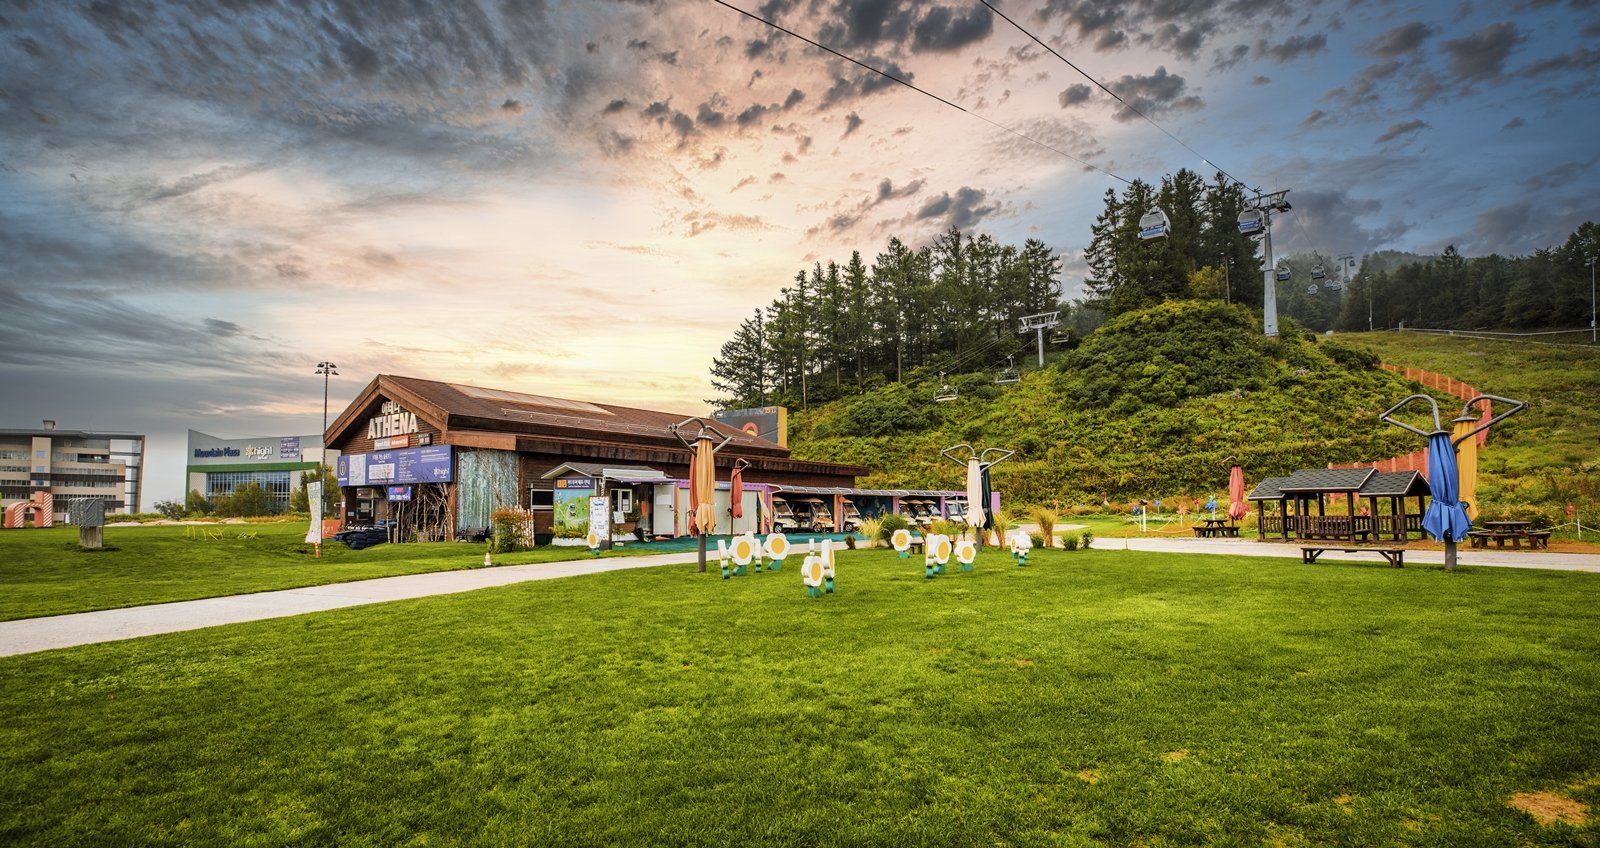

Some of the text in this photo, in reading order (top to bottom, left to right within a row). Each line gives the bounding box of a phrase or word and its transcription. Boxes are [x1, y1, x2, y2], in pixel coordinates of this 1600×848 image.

[367, 412, 419, 439] ATHENA
[194, 446, 240, 458] Mountain Plaza
